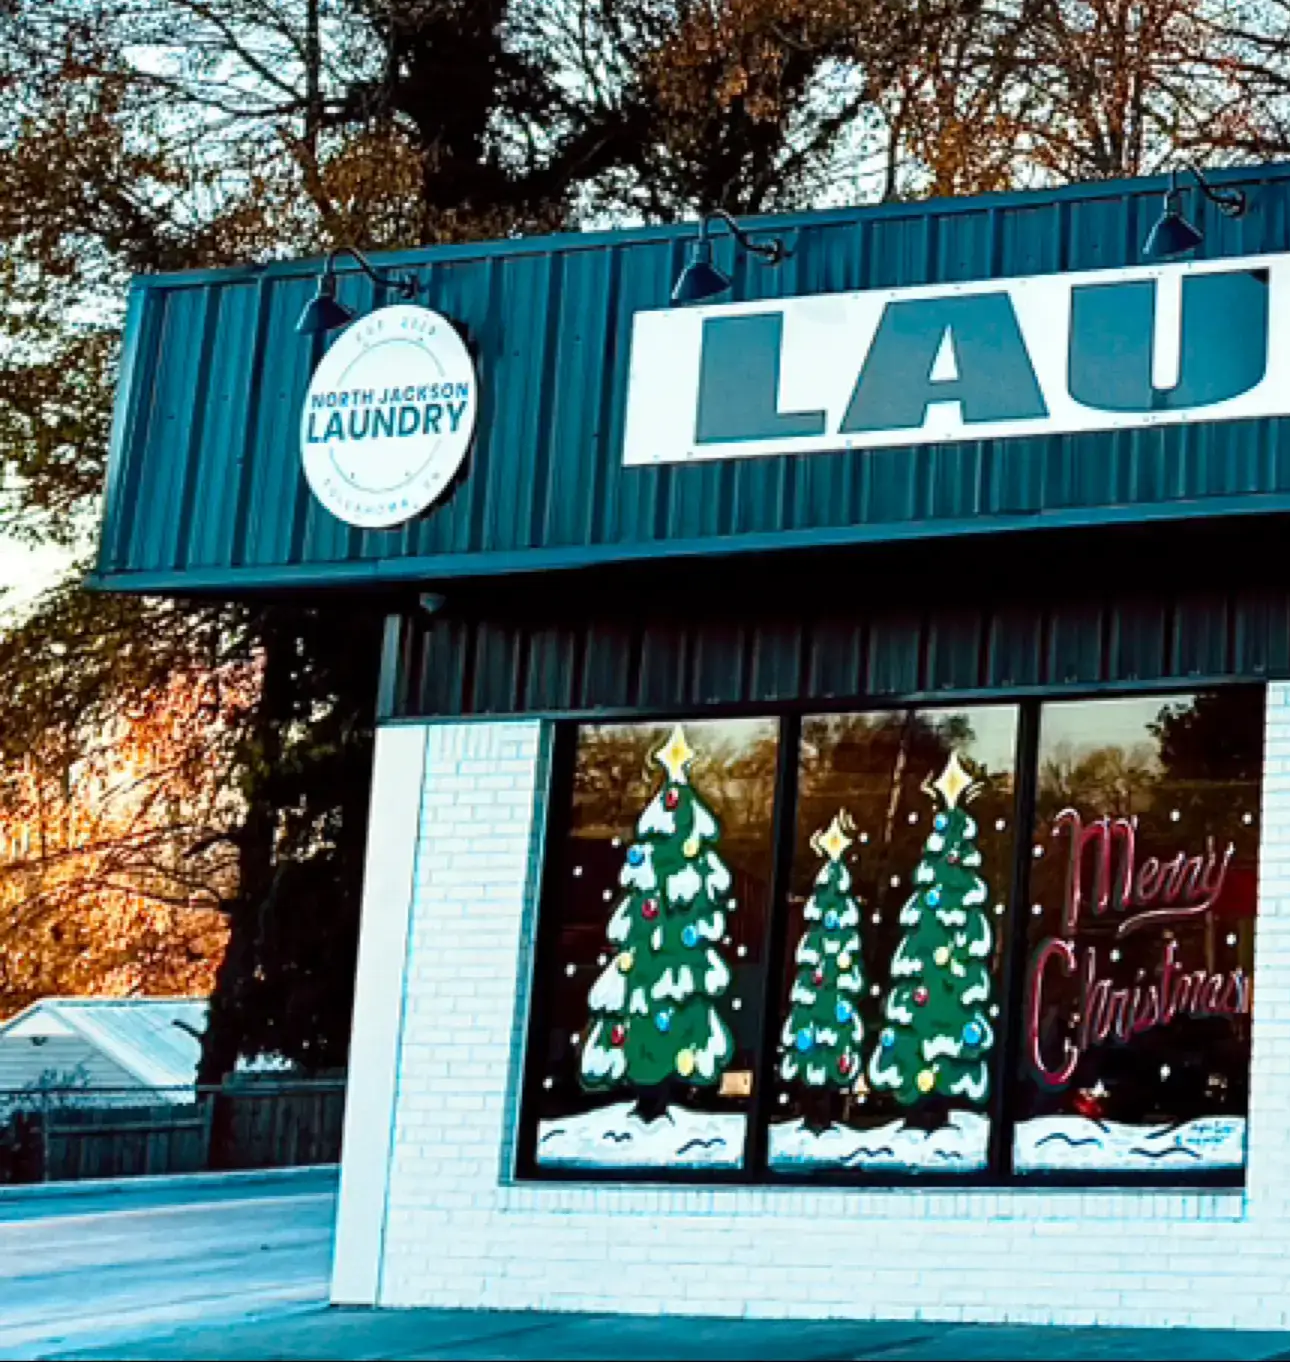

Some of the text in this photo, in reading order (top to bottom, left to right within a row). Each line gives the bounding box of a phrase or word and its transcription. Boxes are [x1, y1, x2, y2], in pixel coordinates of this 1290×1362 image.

[306, 400, 467, 445] LAUNDRY
[311, 382, 469, 410] NORTH JACKSON
[1051, 807, 1236, 936] Merry
[1030, 937, 1250, 1088] Christmas
